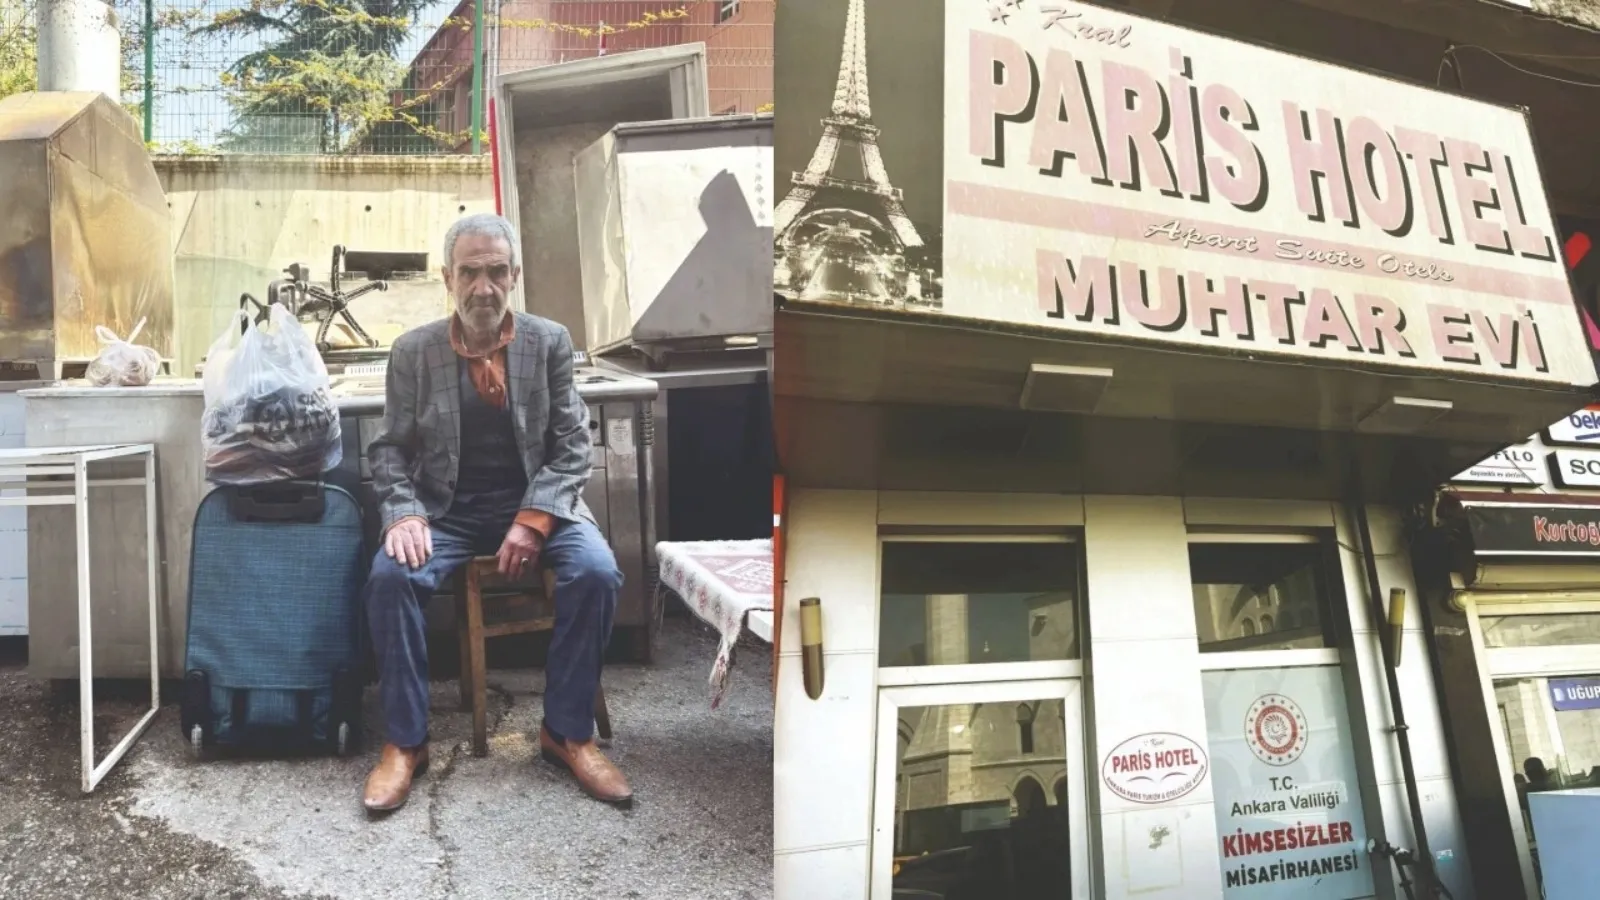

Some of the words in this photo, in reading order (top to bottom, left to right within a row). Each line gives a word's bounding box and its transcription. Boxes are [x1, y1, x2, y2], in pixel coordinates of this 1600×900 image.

[1040, 5, 1132, 49] Kral
[969, 28, 1270, 213] PARİS
[1281, 100, 1557, 263] HOTEL
[1144, 219, 1259, 253] Apart
[1275, 238, 1365, 268] Suite
[1376, 253, 1455, 282] Otels
[1036, 248, 1417, 359] MUHTAR
[1426, 302, 1550, 373] EVİ
[1533, 515, 1600, 546] Kurtoğ
[1112, 749, 1151, 773] PARİS
[1154, 748, 1198, 769] HOTEL
[1269, 776, 1298, 791] T.C.
[1230, 799, 1286, 817] Ankara
[1290, 793, 1340, 809] Valiliği
[1222, 820, 1354, 858] KİMSESİZLER
[1226, 849, 1358, 888] MİSAFİRHANESİ
